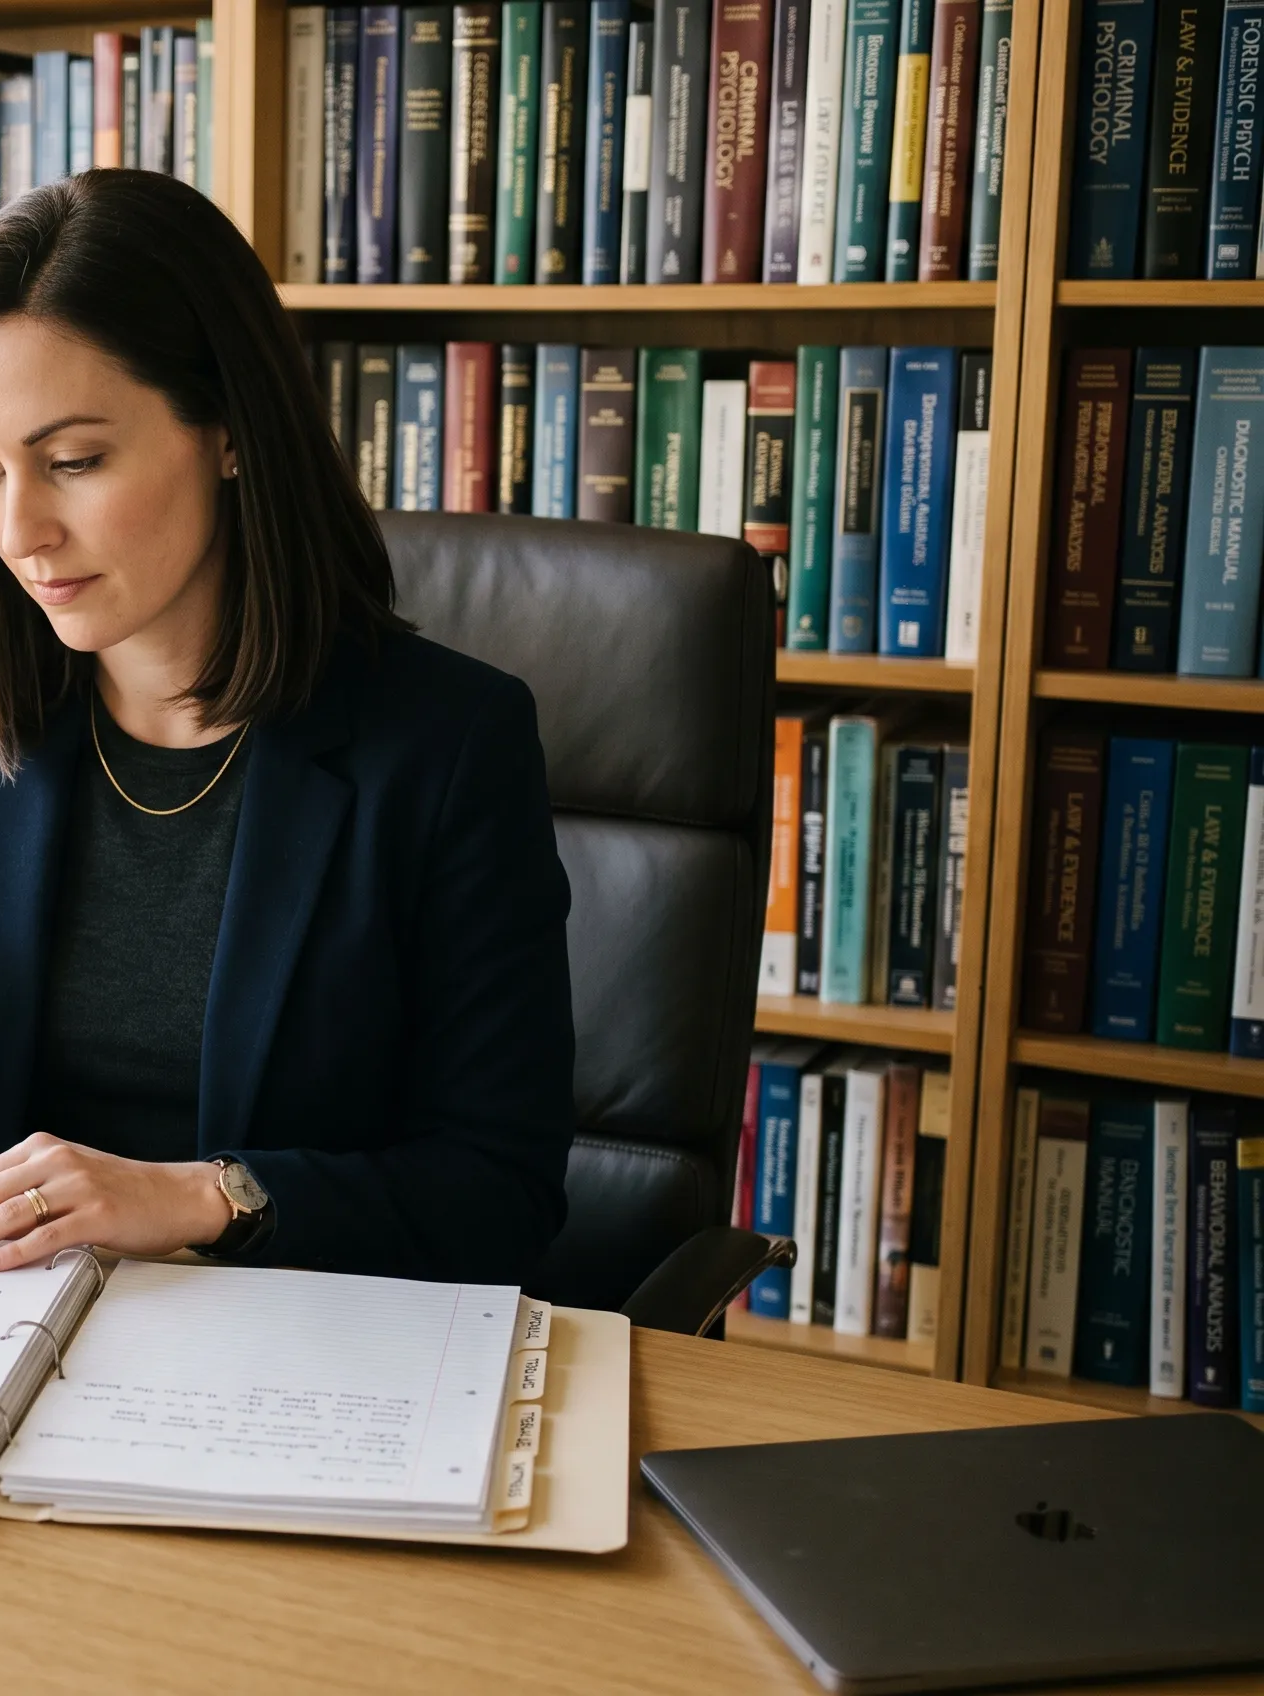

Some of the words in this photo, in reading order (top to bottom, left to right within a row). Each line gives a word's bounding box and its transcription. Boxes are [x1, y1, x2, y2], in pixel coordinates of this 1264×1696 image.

[1176, 56, 1194, 72] &
[1179, 8, 1197, 51] LAW
[1237, 18, 1262, 112] FORENSIC
[1089, 21, 1115, 165] PSYCHOLOGY
[1111, 39, 1137, 147] CRIMINAL
[1169, 76, 1193, 174] EVIDENCE
[1203, 804, 1222, 846] LAW
[1194, 867, 1218, 958] EVIDENCE
